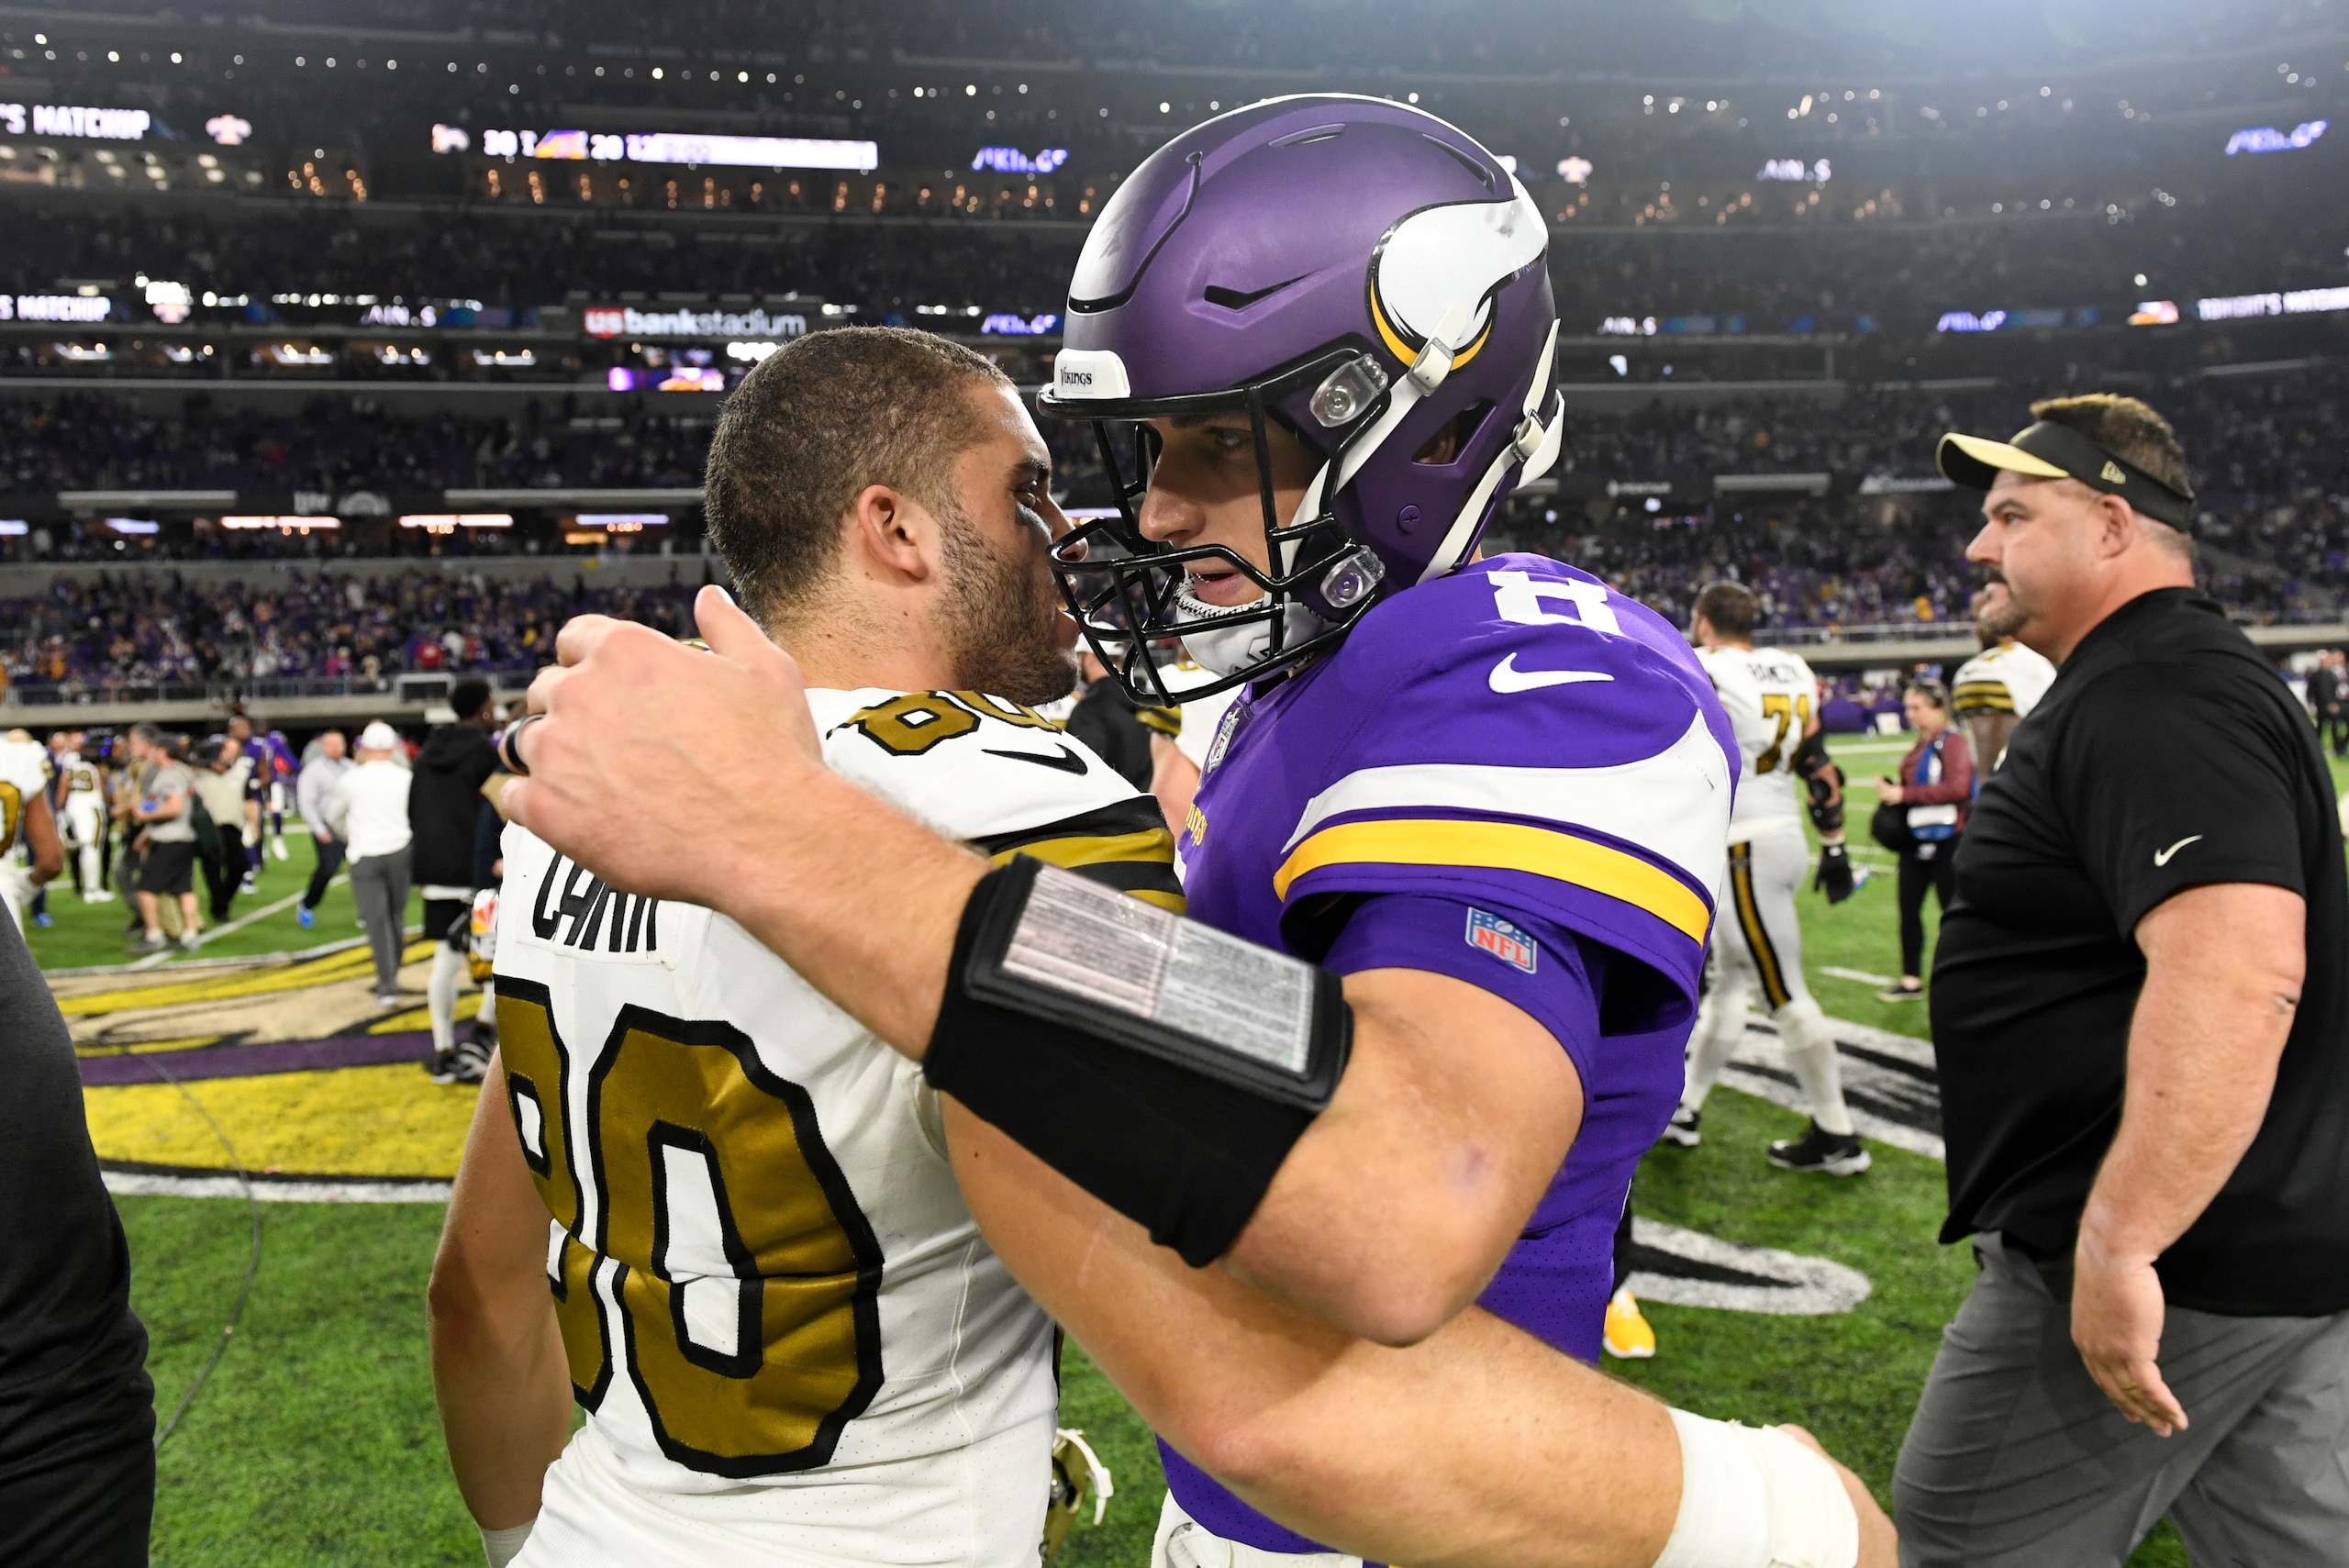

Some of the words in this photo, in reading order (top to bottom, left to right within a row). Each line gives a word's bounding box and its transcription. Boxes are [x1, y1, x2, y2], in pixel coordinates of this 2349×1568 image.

[33, 105, 150, 139] MATCHUP
[1756, 694, 1809, 774] 71
[1476, 927, 1529, 966] NFL
[493, 973, 885, 1479] 80
